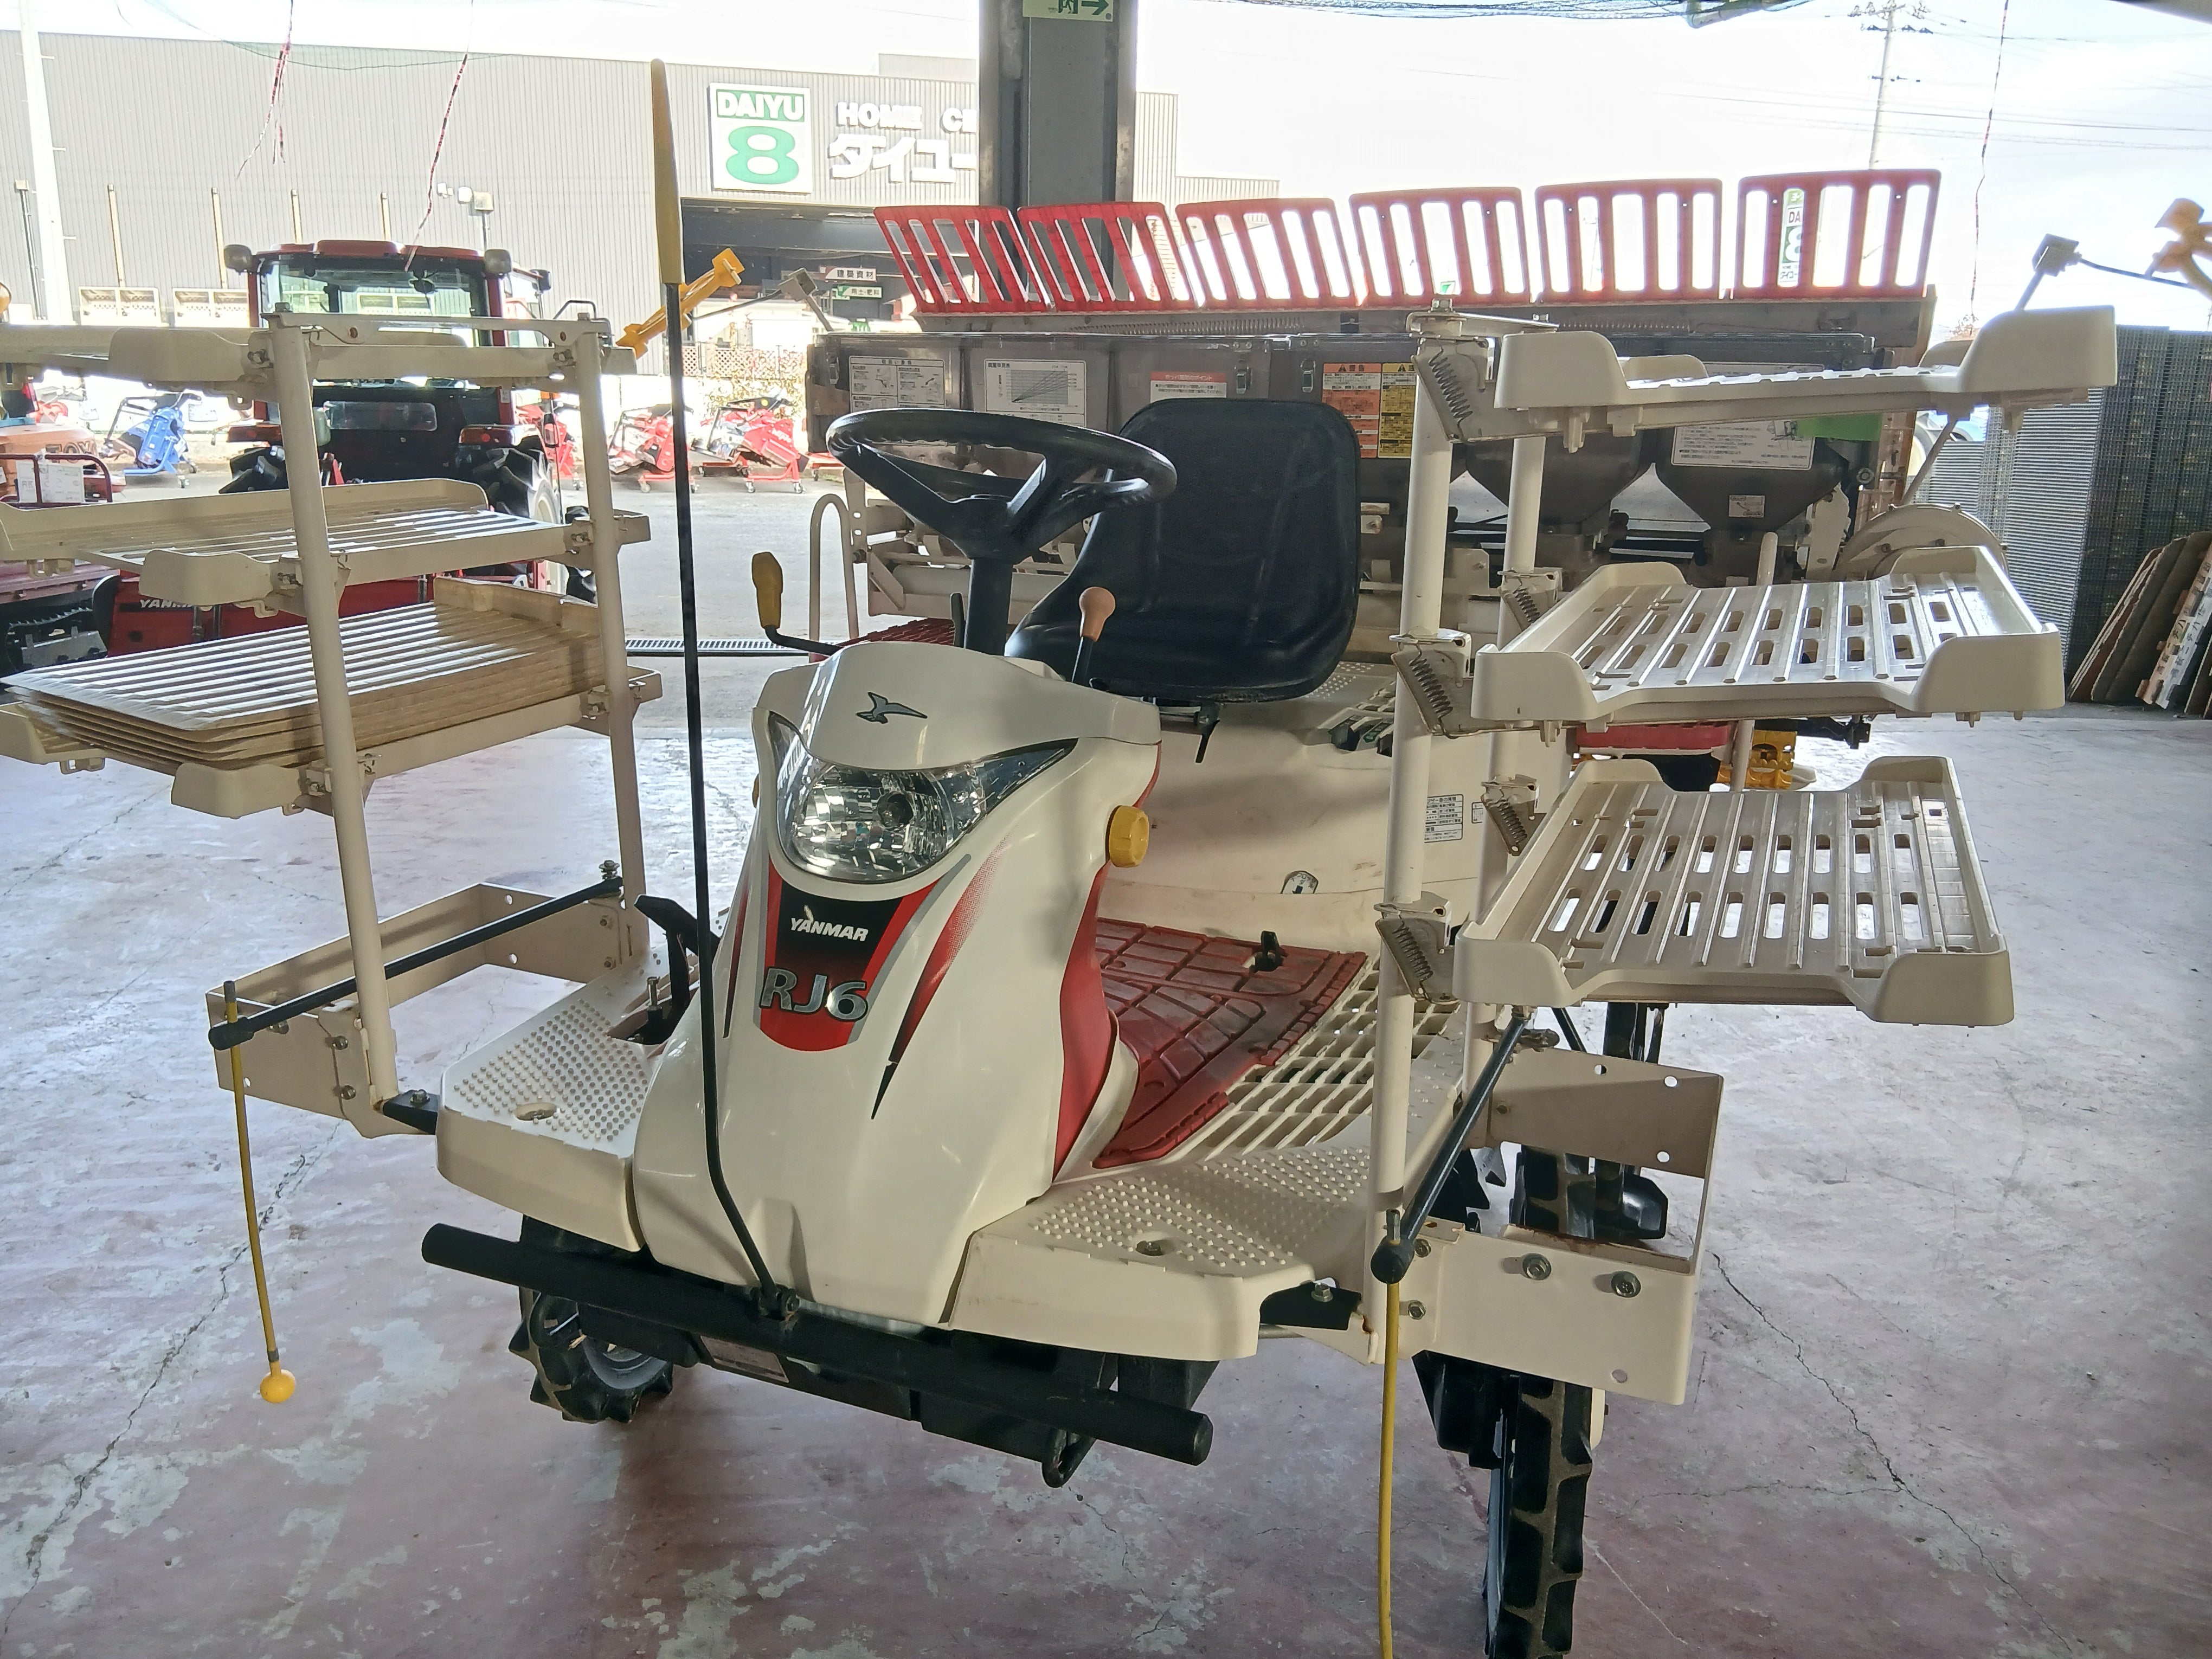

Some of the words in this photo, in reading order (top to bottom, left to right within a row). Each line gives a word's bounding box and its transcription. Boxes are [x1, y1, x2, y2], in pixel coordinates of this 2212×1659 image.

[717, 92, 804, 120] DAIYU
[837, 102, 922, 130] HOME
[726, 125, 800, 185] 8
[829, 133, 977, 183] ダイユー
[837, 269, 873, 279] 建築資材
[790, 917, 869, 942] YANMAR
[760, 967, 868, 1023] RJ6
